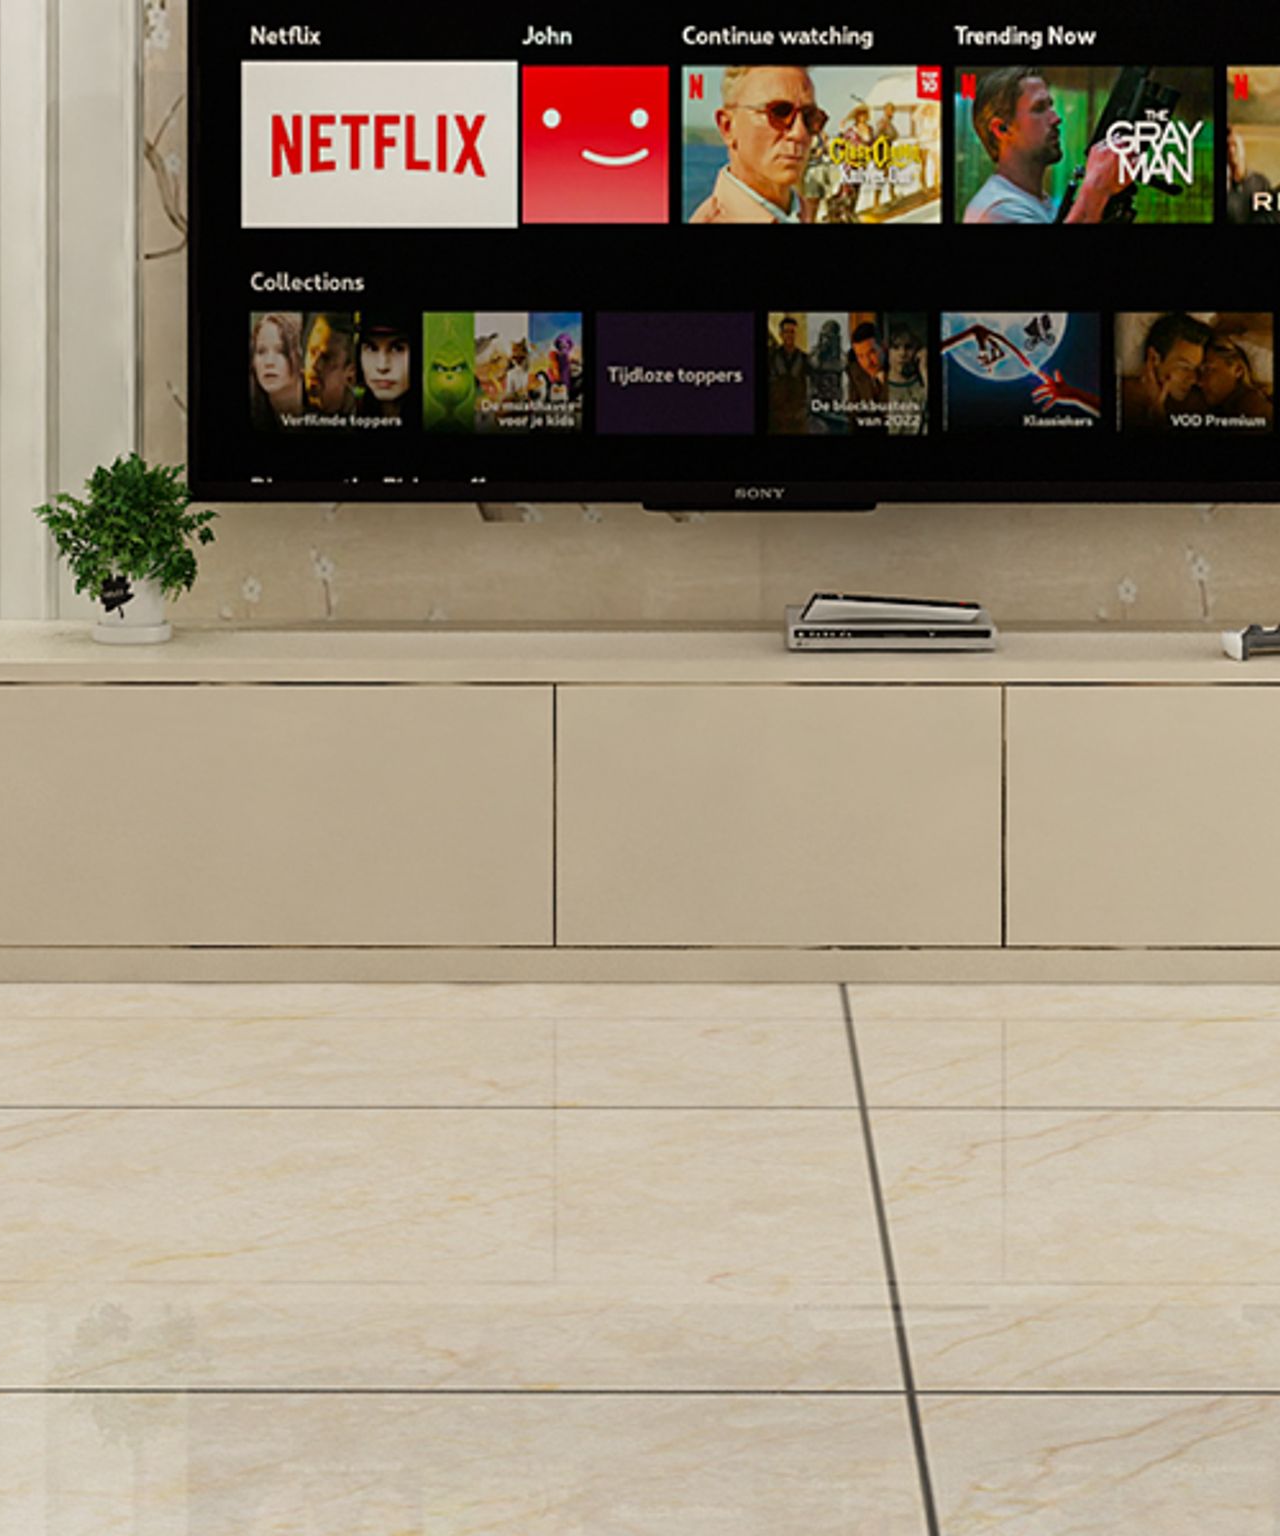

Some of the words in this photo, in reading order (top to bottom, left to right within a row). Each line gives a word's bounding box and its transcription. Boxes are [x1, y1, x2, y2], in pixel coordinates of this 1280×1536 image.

[250, 25, 321, 45] Netflix
[522, 25, 573, 46] John
[682, 25, 775, 46] Continue
[779, 25, 874, 50] watching
[954, 25, 1043, 50] Trending
[1047, 25, 1097, 46] Now
[688, 74, 704, 100] N
[961, 74, 976, 100] N
[1234, 74, 1249, 101] N
[1144, 110, 1169, 122] THE
[271, 114, 488, 178] NETFLIX
[1105, 121, 1204, 156] GRAY
[1119, 148, 1194, 185] MAN
[250, 271, 365, 292] Collections
[607, 366, 675, 386] Tijdloze
[677, 367, 743, 386] toppers
[811, 399, 830, 412] De
[833, 399, 920, 412] blockbusters
[281, 414, 347, 427] Verfilmde
[349, 414, 402, 428] toppers
[498, 416, 529, 427] voor
[530, 414, 544, 429] je
[546, 413, 575, 427] kids
[857, 416, 882, 427] van
[884, 414, 921, 427] 2022
[1023, 414, 1093, 427] Klassiekers
[1170, 414, 1203, 427] VOD
[1205, 414, 1266, 427] Premium
[734, 487, 785, 499] SONY
